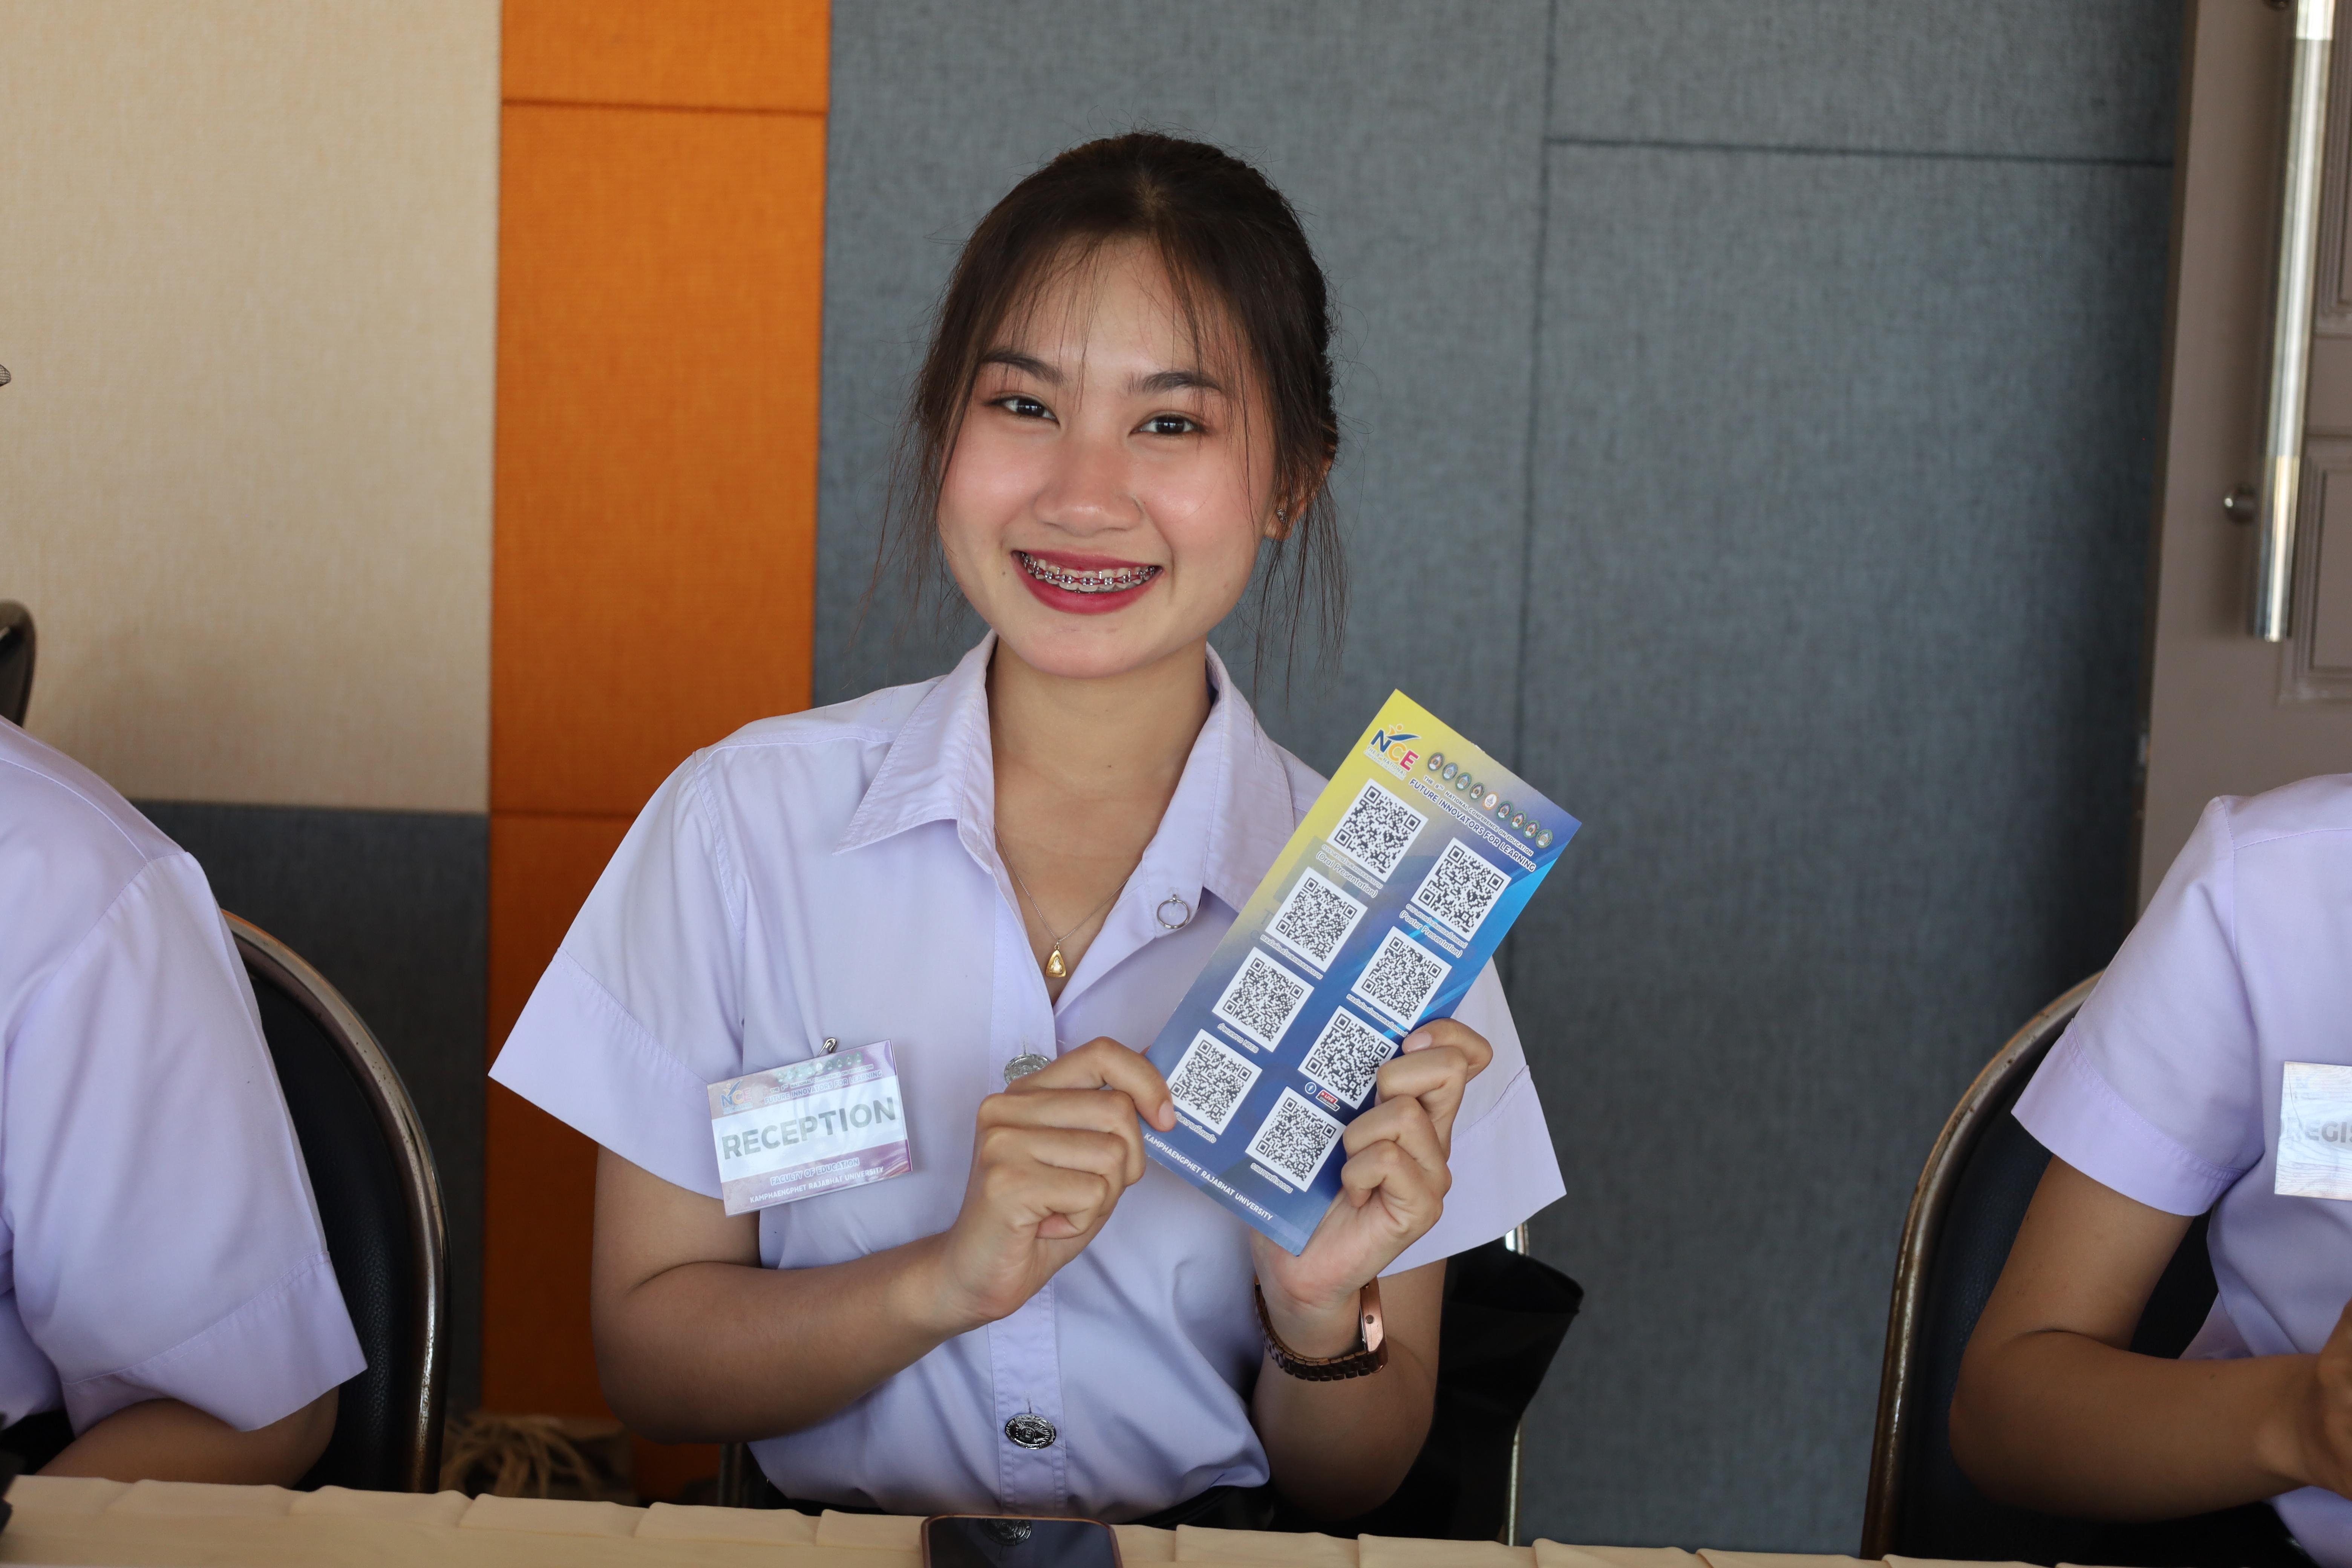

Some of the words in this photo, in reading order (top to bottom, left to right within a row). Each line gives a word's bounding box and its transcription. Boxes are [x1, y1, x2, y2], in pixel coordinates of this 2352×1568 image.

[1366, 746, 1377, 755] THE
[1382, 757, 1407, 776] NATIONAL
[1370, 729, 1419, 771] NCE
[1409, 778, 1439, 802] FUTURE
[1438, 799, 1485, 835] INNOVATORS
[1484, 831, 1500, 846] FOR
[1499, 843, 1536, 871] LEARNING
[1423, 776, 1433, 784] THE
[1444, 791, 1468, 810] NATIONAL
[1468, 808, 1499, 831] CONFERENCE
[1506, 835, 1533, 856] EDUCATION
[1316, 851, 1334, 867] (Oral
[1333, 863, 1378, 898] Presentation)
[1399, 910, 1423, 930] (Poster
[1421, 925, 1463, 958] Presentation)
[765, 1092, 790, 1104] FUTURE
[791, 1084, 833, 1097] INNOVATORS
[850, 1070, 882, 1083] LEARNING
[791, 1079, 812, 1087] NATIONAL
[813, 1072, 841, 1081] CONFERENCE
[849, 1064, 873, 1073] EDUCATION
[721, 1089, 752, 1107] NCE
[1324, 1094, 1334, 1103] LIVE
[722, 1097, 896, 1159] RECEPTION
[750, 1184, 806, 1203] KAMPHAENGPHET
[808, 1176, 842, 1189] RAJABHAT
[845, 1166, 884, 1181] UNIVERSITY
[771, 1171, 802, 1185] FACULTY
[805, 1168, 815, 1177] OF
[817, 1158, 859, 1174] EDUCATION
[1144, 1133, 1201, 1174] KAMPHAENGPHET
[1200, 1170, 1235, 1196] RAJABHAT
[1234, 1193, 1273, 1221] UNIVERSITY
